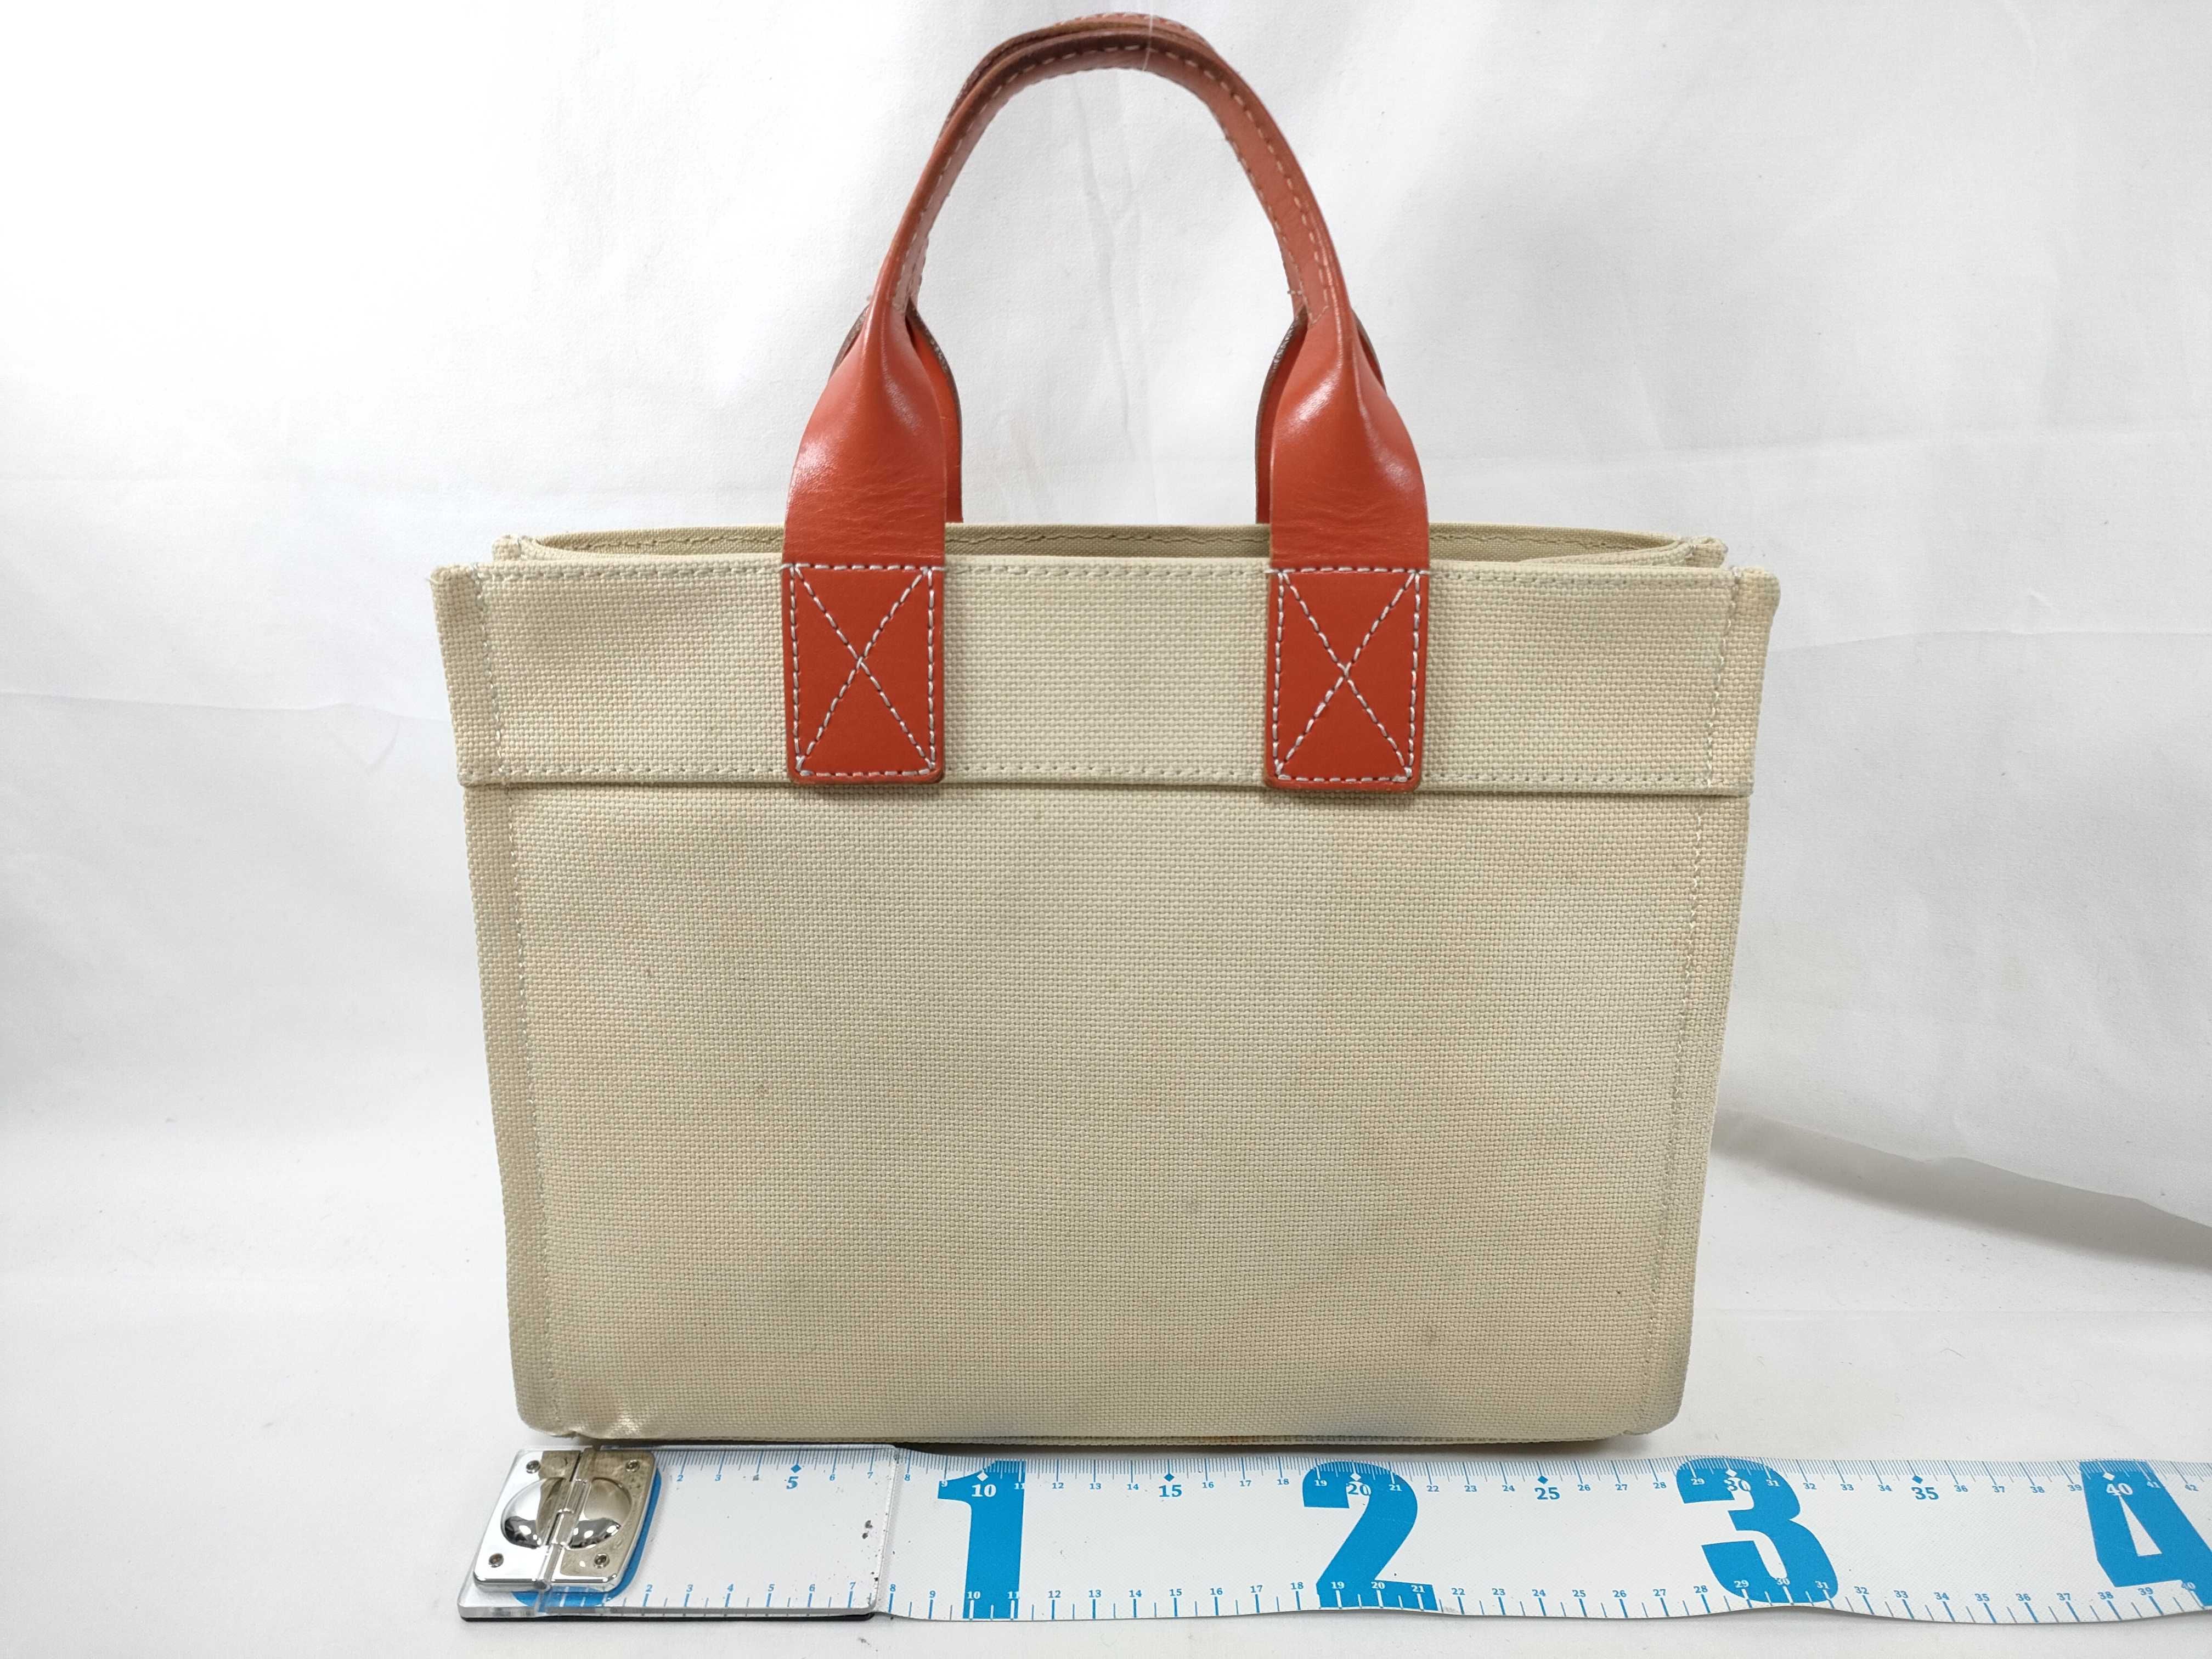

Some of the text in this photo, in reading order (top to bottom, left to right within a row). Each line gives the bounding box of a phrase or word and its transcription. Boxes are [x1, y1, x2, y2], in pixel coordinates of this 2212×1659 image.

[786, 1476, 798, 1489] 5
[972, 1484, 996, 1497] 10
[1159, 1485, 1183, 1497] 15
[1346, 1482, 1372, 1496] 20
[1502, 1484, 1515, 1492] 24
[1534, 1487, 1560, 1500] 25
[1724, 1478, 1751, 1493] 30
[1911, 1487, 1939, 1500] 35
[1992, 1485, 2006, 1493] 37
[2068, 1484, 2082, 1492] 39
[2106, 1483, 2133, 1496] 40
[937, 1460, 1026, 1619] 1
[1302, 1461, 1438, 1611] 2
[1676, 1458, 1838, 1603] 3
[967, 1591, 980, 1599] 10
[1048, 1590, 1061, 1598] 12
[1088, 1589, 1102, 1598] 13
[1128, 1589, 1142, 1598] 14
[1169, 1589, 1182, 1597] 15
[1210, 1587, 1223, 1595] 16
[1330, 1581, 1345, 1589] 19
[1371, 1582, 1385, 1590] 20
[1411, 1584, 1425, 1593] 21
[1694, 1585, 1708, 1593] 28
[1734, 1580, 1749, 1589] 29
[1776, 1577, 1790, 1586] 30
[1815, 1580, 1830, 1589] 31
[1854, 1587, 1870, 1595] 32
[1893, 1590, 1909, 1599] 33
[1934, 1592, 1950, 1601] 34
[2057, 1593, 2072, 1601] 37
[2097, 1591, 2114, 1600] 38
[2138, 1587, 2153, 1595] 39
